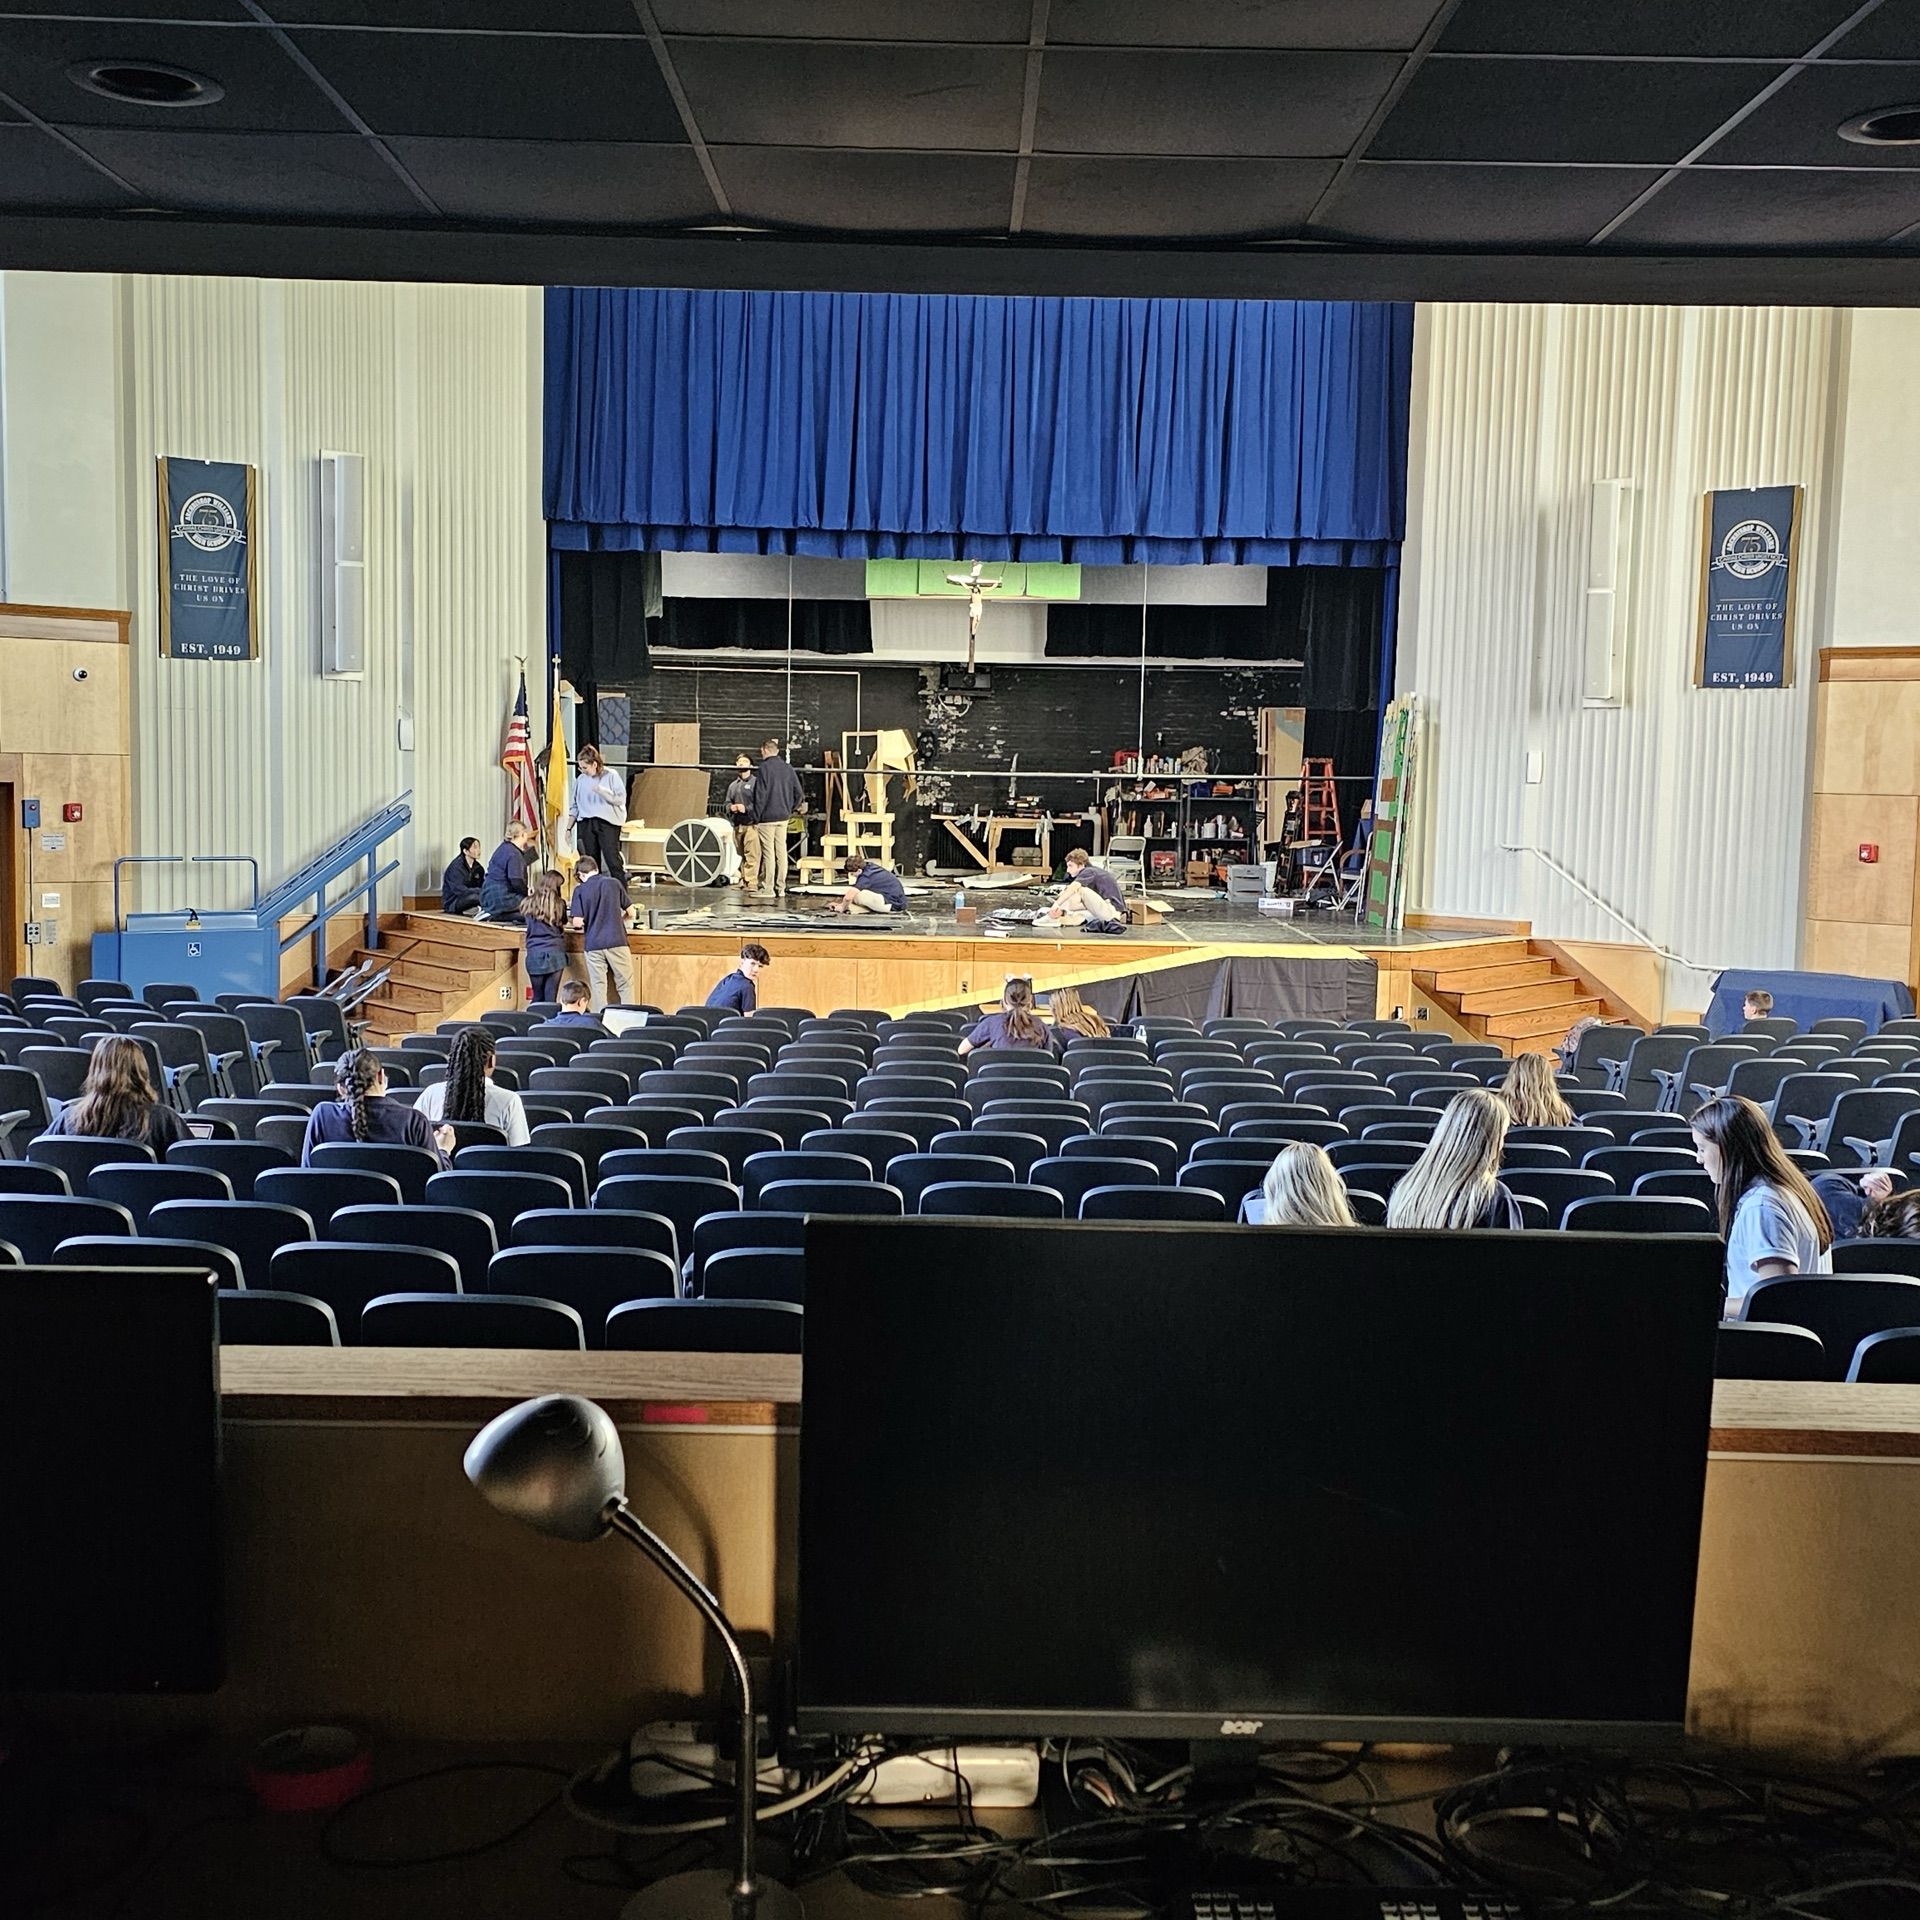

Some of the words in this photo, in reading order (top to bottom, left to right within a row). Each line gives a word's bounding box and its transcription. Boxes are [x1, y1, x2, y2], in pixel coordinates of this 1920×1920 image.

[199, 508, 220, 526] 75
[1740, 536, 1761, 553] 75
[179, 573, 198, 582] THE
[201, 575, 226, 584] LOVE
[174, 583, 209, 593] CHRIST
[212, 585, 245, 594] DRIVES
[196, 594, 209, 602] US
[211, 595, 224, 603] ON
[1715, 604, 1734, 612] THE
[1737, 603, 1763, 611] LOVE
[1765, 602, 1778, 610] OF
[1710, 613, 1745, 621] CHRIST
[1748, 612, 1783, 620] DRIVES
[1731, 622, 1743, 631] US
[1746, 622, 1760, 630] ON
[181, 643, 208, 655] EST.
[212, 644, 241, 655] 1949
[1712, 672, 1740, 683] EST.
[1744, 672, 1774, 683] 1949
[1220, 1720, 1264, 1735] acer
